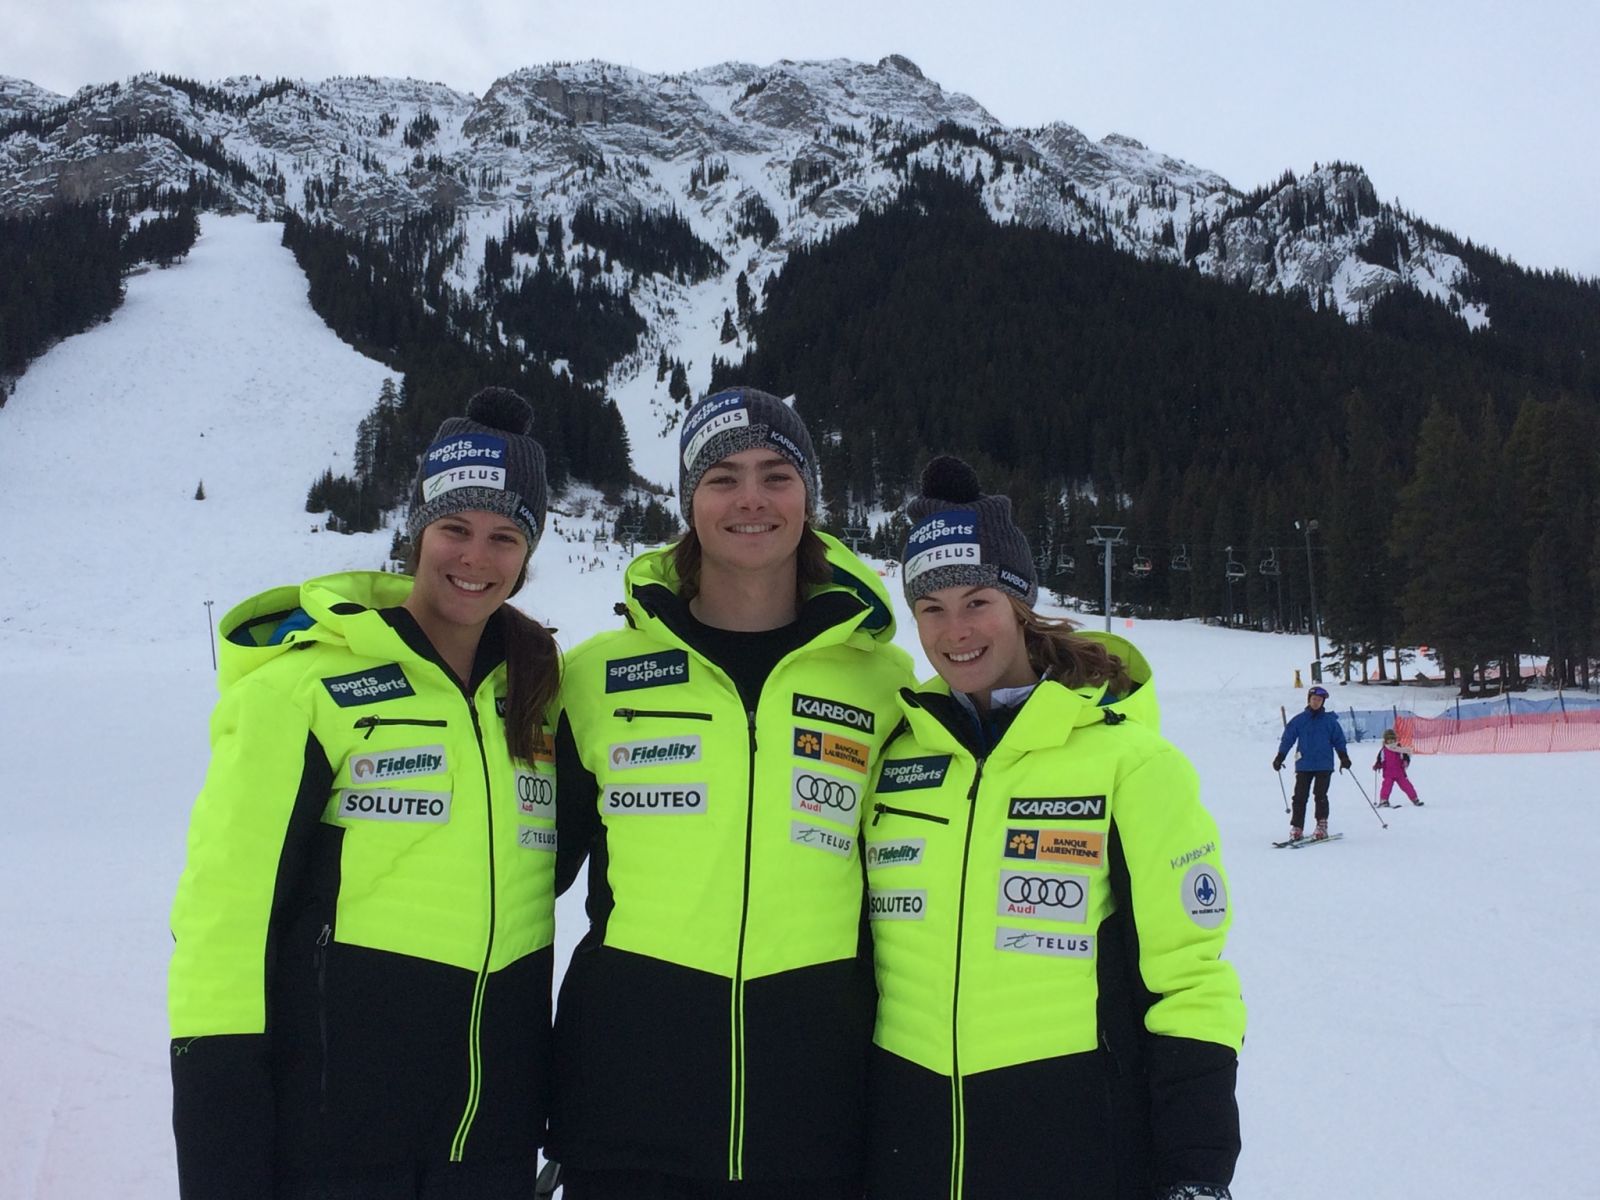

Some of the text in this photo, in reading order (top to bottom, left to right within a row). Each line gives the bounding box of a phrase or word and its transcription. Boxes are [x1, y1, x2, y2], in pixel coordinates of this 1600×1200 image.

[700, 412, 742, 438] TELUS
[429, 440, 472, 461] sports
[442, 448, 501, 462] experts
[771, 431, 804, 462] KARBON
[449, 470, 499, 482] TELUS
[908, 519, 945, 543] sports
[919, 525, 973, 543] experts
[927, 547, 975, 562] TELUS
[1000, 570, 1029, 591] KARBON
[610, 660, 657, 677] sports
[627, 664, 684, 681] experts
[330, 676, 378, 693] sports
[353, 678, 406, 697] experts
[796, 698, 872, 729] KARBON
[631, 743, 696, 761] Fidelity
[834, 743, 859, 756] BANQUE
[376, 753, 442, 773] Fidelity
[883, 763, 924, 777] sports
[896, 769, 944, 784] experts
[345, 794, 444, 816] SOLUTEO
[609, 791, 701, 808] SOLUTEO
[800, 800, 822, 813] Audi
[1012, 800, 1101, 815] KARBON
[533, 832, 556, 845] TELUS
[820, 832, 851, 851] TELUS
[1053, 838, 1088, 848] BANQUE
[877, 845, 920, 861] Fidelity
[1041, 846, 1099, 859] LAURENTIENNE
[870, 896, 923, 913] SOLUTEO
[1007, 904, 1036, 914] Audi
[1036, 936, 1089, 951] TELUS
